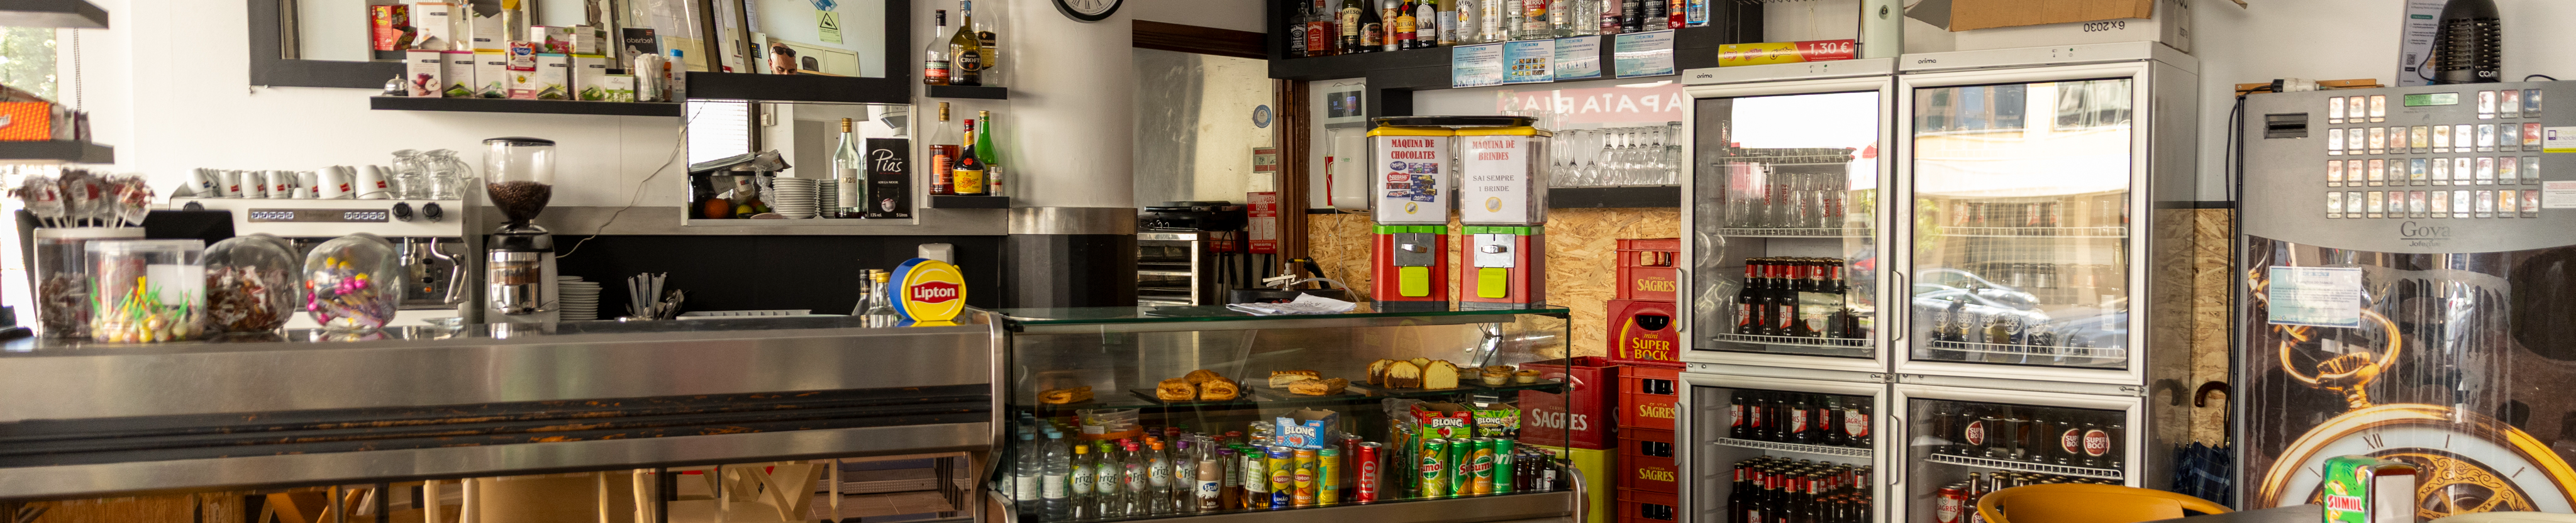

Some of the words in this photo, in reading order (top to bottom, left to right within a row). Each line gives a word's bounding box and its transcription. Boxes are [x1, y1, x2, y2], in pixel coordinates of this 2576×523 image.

[1455, 0, 1474, 9] MALIBU
[1342, 9, 1362, 17] JAMESON
[1809, 42, 1837, 56] 1,30
[1840, 42, 1850, 53] €
[1391, 138, 1423, 148] MÁQUINA
[1426, 139, 1435, 148] DE
[1472, 140, 1504, 149] MÁQUINA
[1506, 140, 1515, 148] DE
[872, 148, 903, 172] Pias
[1391, 151, 1435, 160] CHOCOLATES
[1478, 152, 1509, 160] BRINDES
[1637, 278, 1675, 292] SAGRES
[914, 286, 955, 300] Lipton
[1632, 337, 1670, 350] SUPER
[1634, 349, 1668, 361] BOCK
[1639, 404, 1675, 419] SAGRES
[1431, 417, 1463, 429] BLONG
[1531, 408, 1587, 431] SAGRES
[1284, 426, 1316, 438] BLONG
[1359, 461, 1376, 494] Bro
[1639, 468, 1675, 482] SAGRES
[1937, 504, 1957, 513] SAGRES
[2327, 495, 2363, 512] SUMOL
